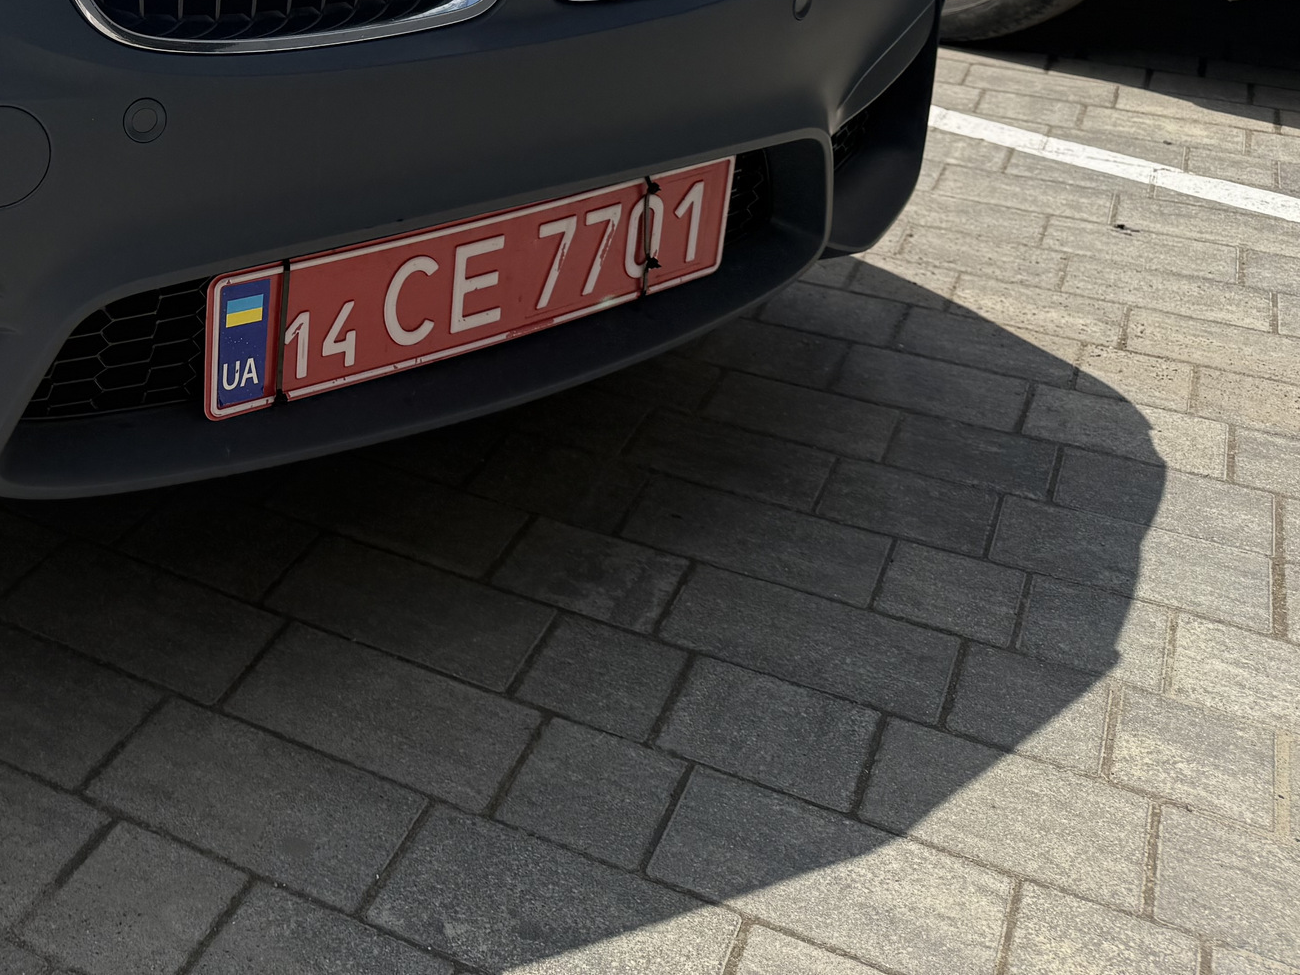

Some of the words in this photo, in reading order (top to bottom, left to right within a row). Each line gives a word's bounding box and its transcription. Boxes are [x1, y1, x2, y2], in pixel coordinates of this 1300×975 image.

[284, 300, 356, 379] 14
[383, 234, 505, 346] CE
[535, 180, 704, 309] 7701
[222, 356, 259, 391] UA
